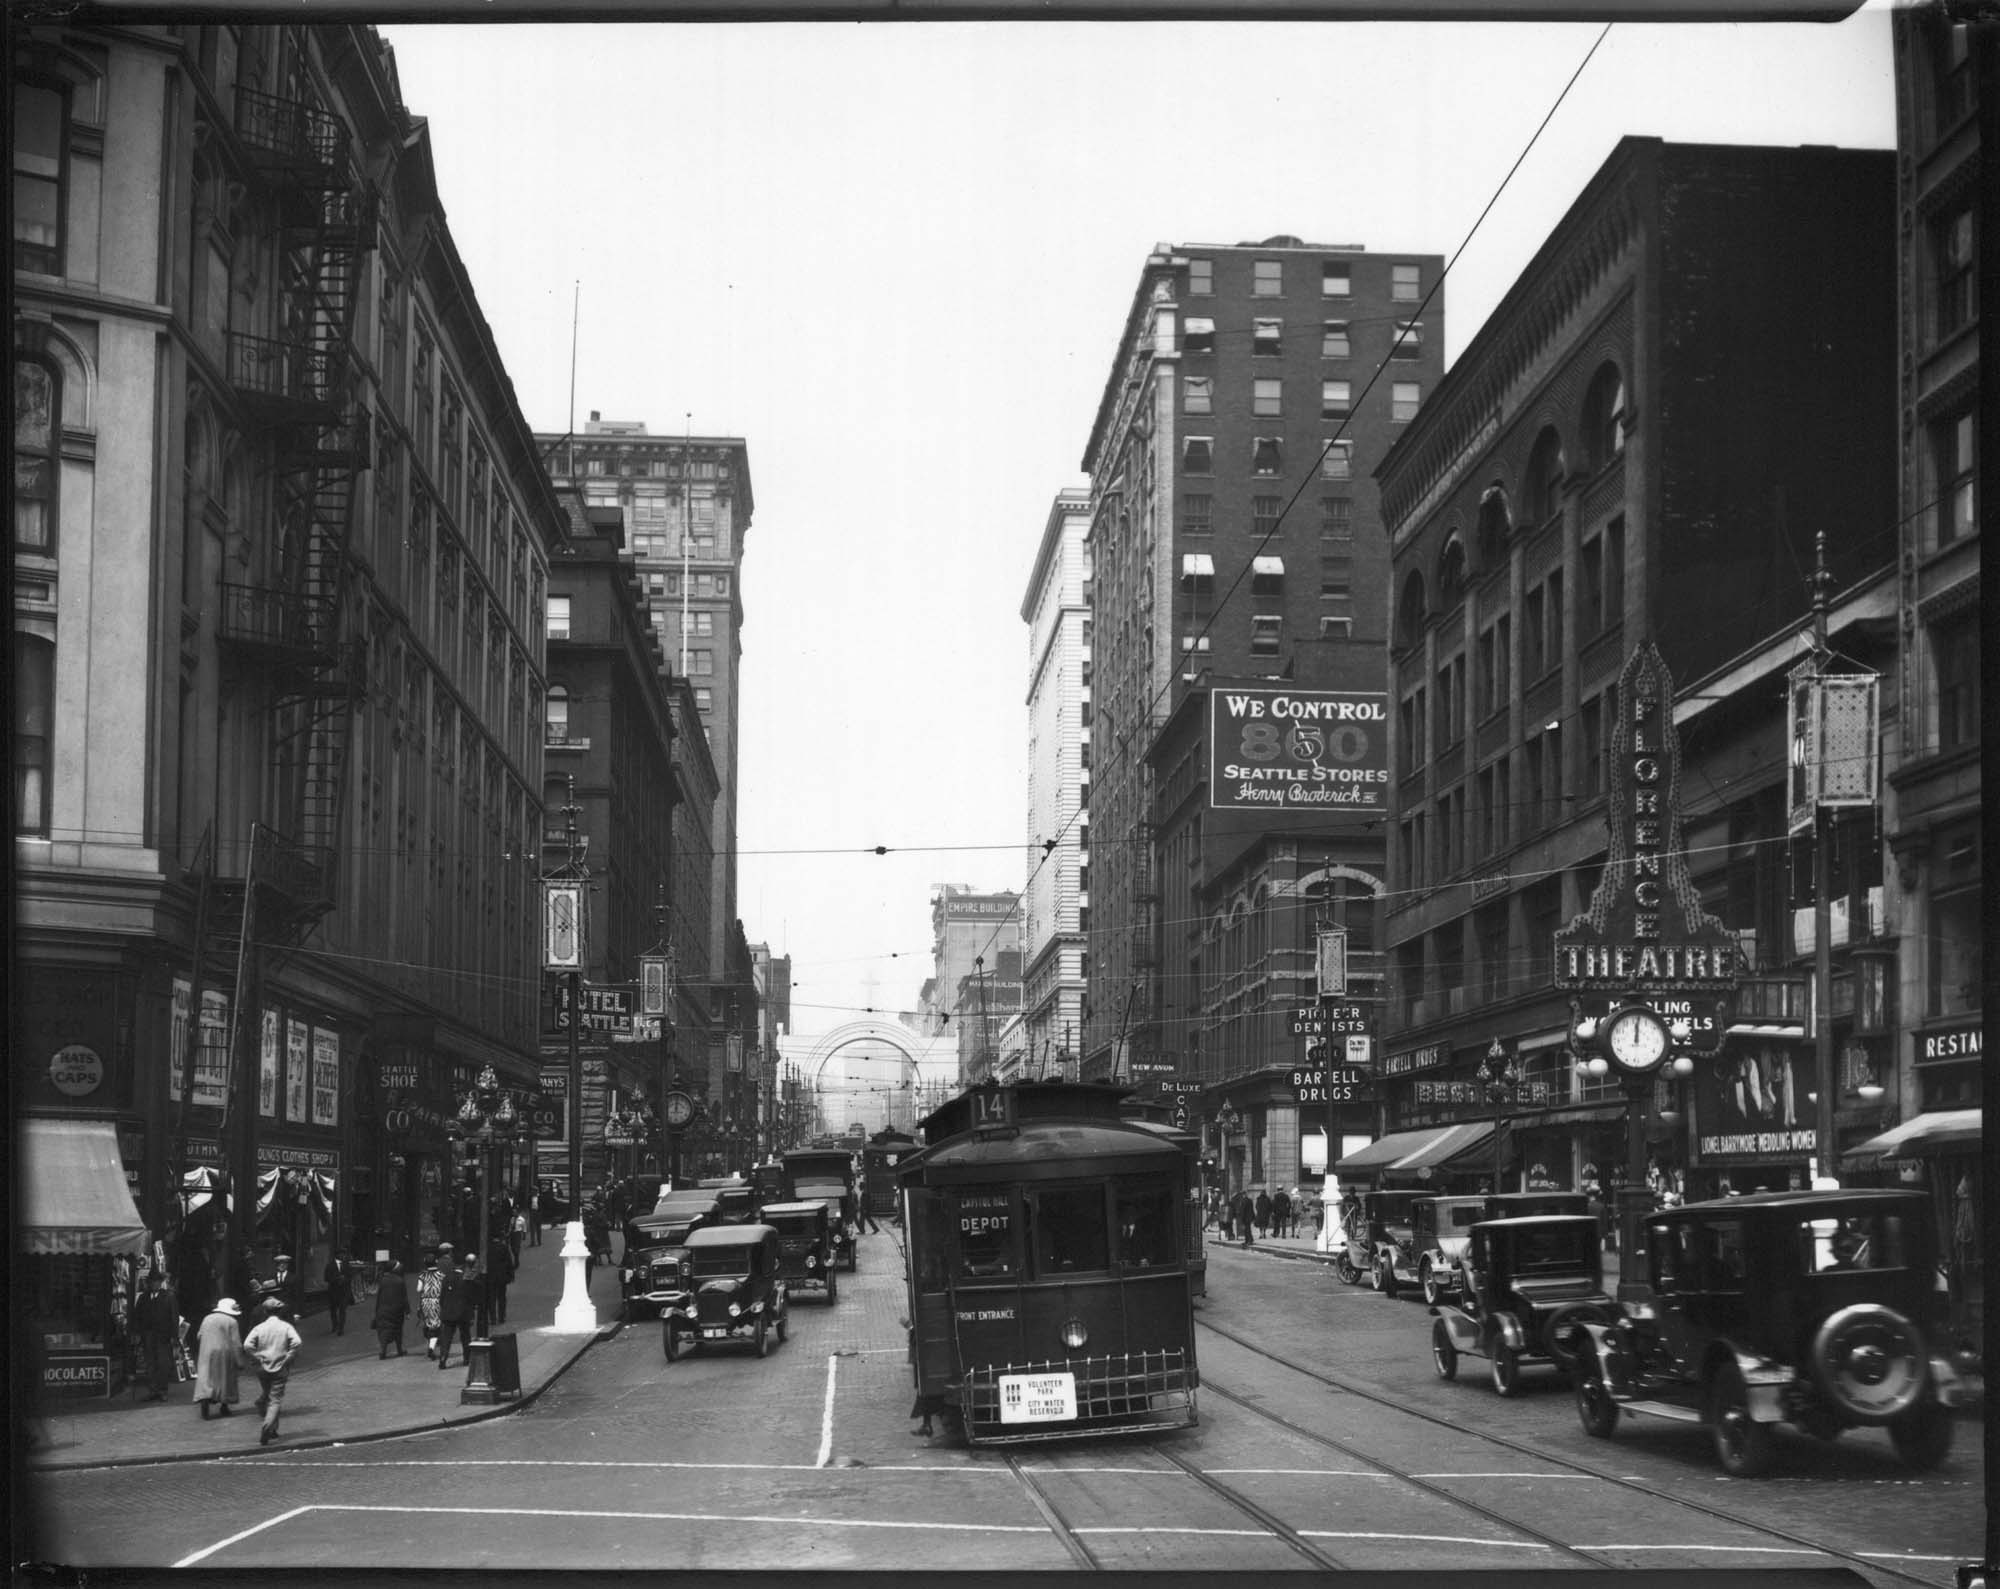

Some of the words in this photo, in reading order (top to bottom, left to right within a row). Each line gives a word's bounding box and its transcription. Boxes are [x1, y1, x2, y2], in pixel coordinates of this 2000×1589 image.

[1271, 697, 1387, 720] CONTROL
[1224, 764, 1309, 781] SEATTLE
[1312, 766, 1388, 783] STORES
[1234, 781, 1285, 806] Henry
[1288, 782, 1362, 803] Broderick
[1634, 696, 1660, 939] FLORENCE
[948, 903, 979, 913] EMPIRE
[979, 903, 1017, 913] BUILDING
[1562, 945, 1735, 978] THEATRE
[1608, 1001, 1692, 1014] MLING
[558, 1012, 631, 1031] SATTLE
[1294, 1021, 1366, 1033] DENISTS
[1926, 1032, 1983, 1058] RESTA
[60, 1053, 95, 1064] HATS
[380, 1065, 418, 1074] SEATTLE
[55, 1072, 97, 1084] CAPS
[379, 1075, 419, 1088] SHOE
[1293, 1071, 1360, 1086] BARELL
[1299, 1087, 1352, 1101] DRUGS
[978, 1094, 1003, 1120] 14
[1701, 1136, 1721, 1154] LIONEL
[1720, 1134, 1757, 1152] BARRYMORE
[1791, 1129, 1817, 1150] WOMEN
[281, 1150, 310, 1163] CLOTHES
[311, 1153, 330, 1164] SHOP
[961, 1216, 1009, 1231] DEPOT
[957, 1311, 976, 1320] FRONT
[978, 1309, 1015, 1320] ENTRANCE
[1028, 1380, 1063, 1388] VOLUNTEER
